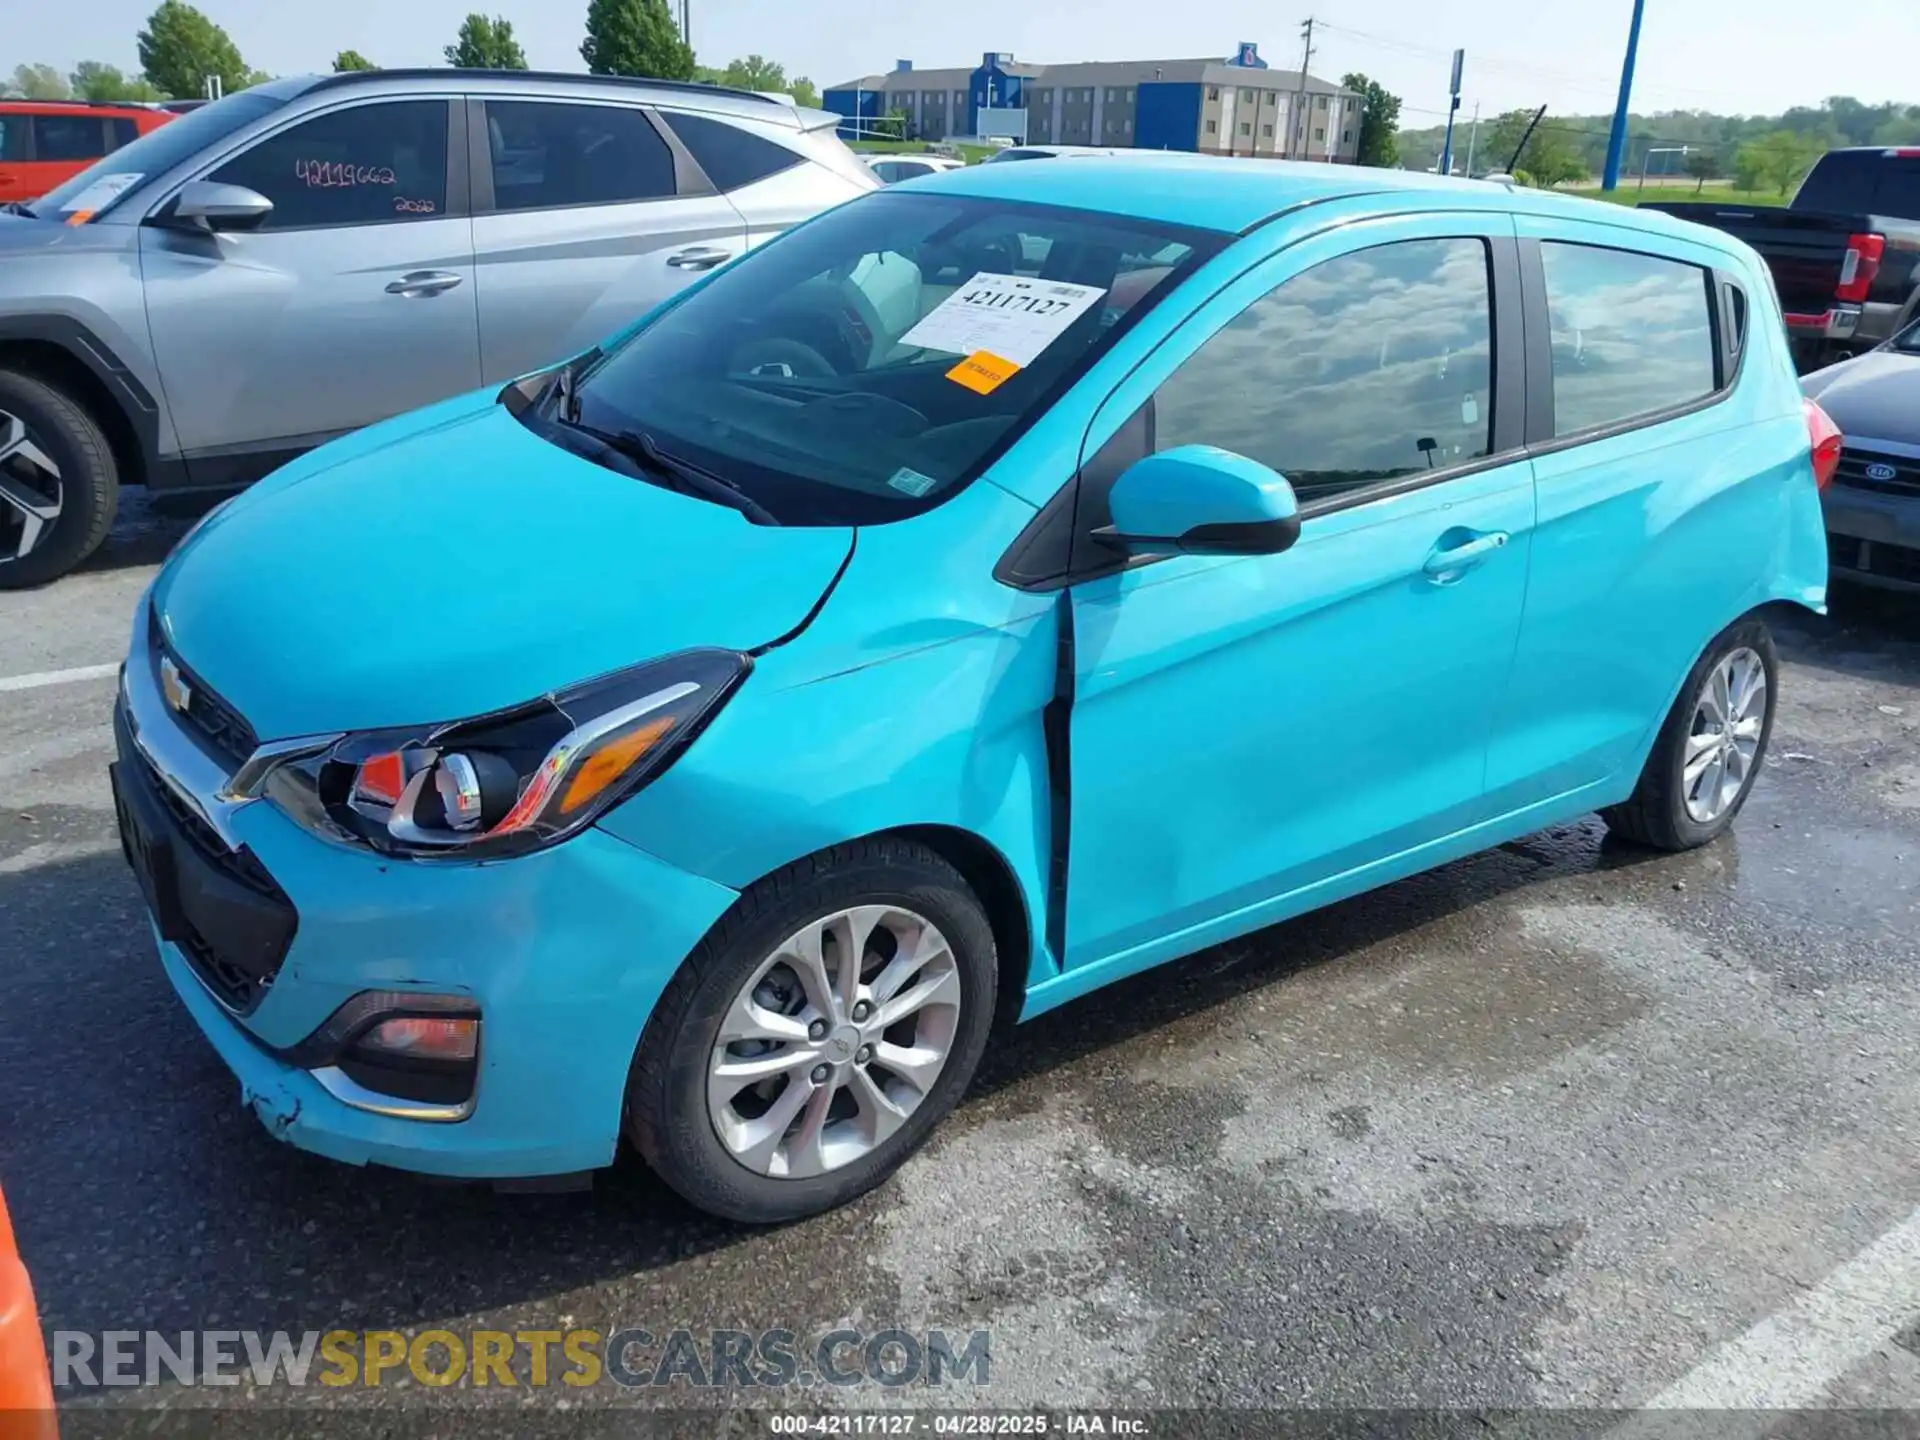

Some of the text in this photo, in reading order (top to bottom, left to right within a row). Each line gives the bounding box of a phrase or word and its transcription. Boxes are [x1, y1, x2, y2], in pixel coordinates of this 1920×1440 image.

[296, 158, 398, 188] 42119662
[393, 196, 436, 213] 2022
[962, 290, 1071, 316] 42117127
